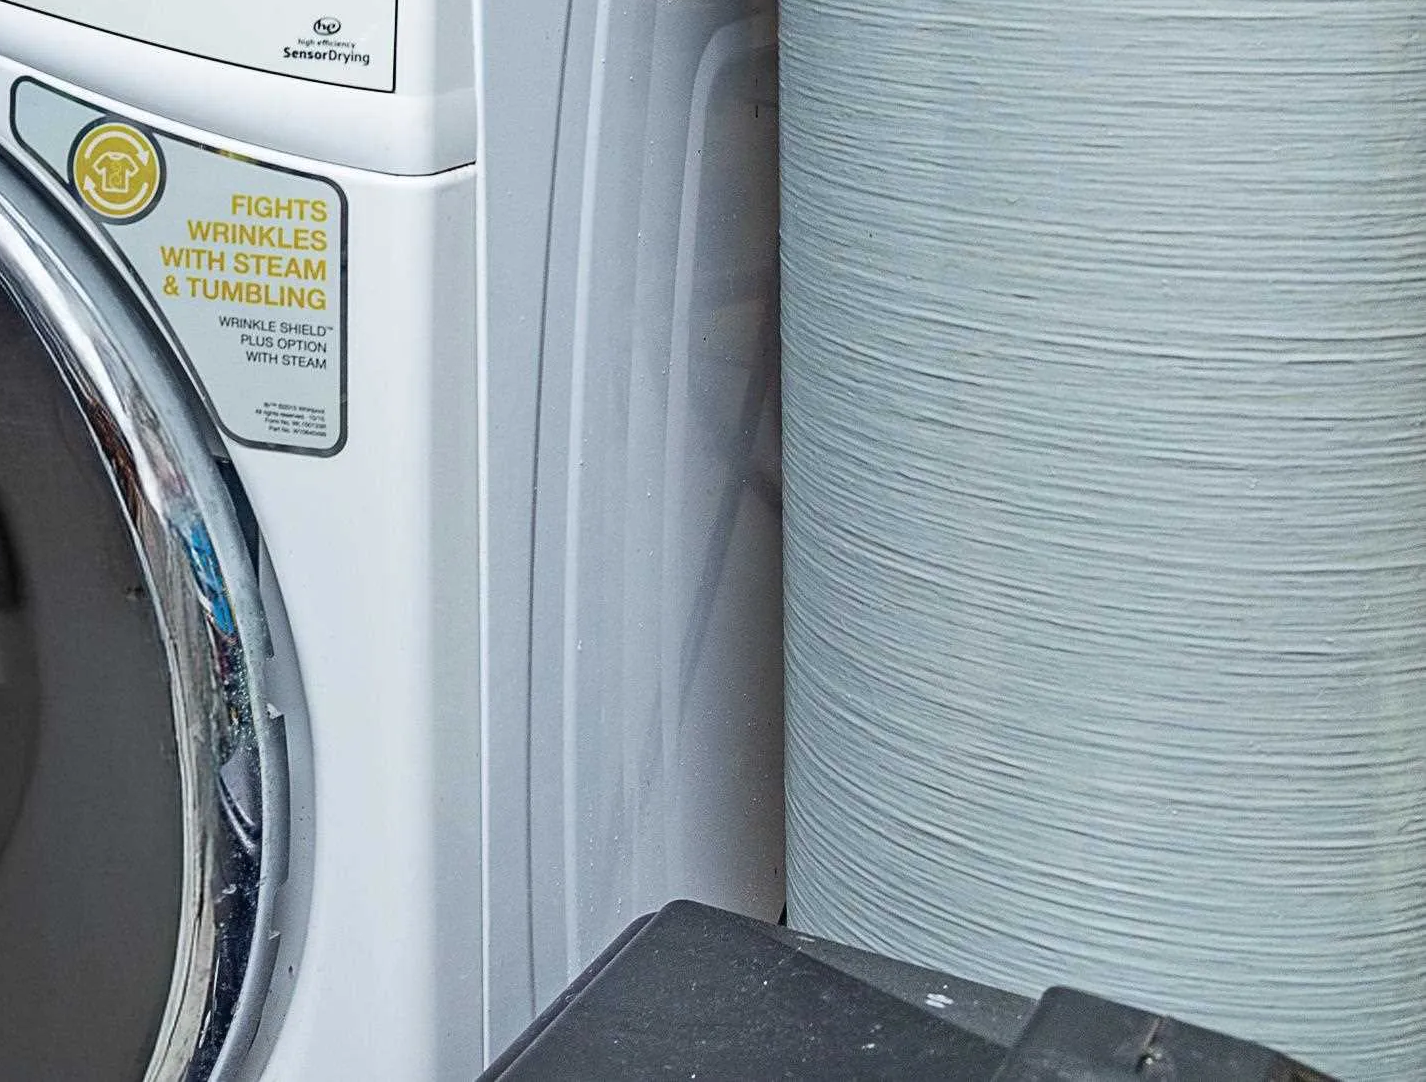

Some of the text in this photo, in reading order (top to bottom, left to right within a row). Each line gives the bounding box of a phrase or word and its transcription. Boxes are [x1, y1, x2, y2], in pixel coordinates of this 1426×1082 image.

[298, 38, 356, 49] high efficiency
[283, 47, 370, 66] SensorDrying
[231, 194, 327, 222] FIGHTS
[187, 220, 327, 251] WRINKLES
[161, 246, 327, 281] WITH STEAM
[163, 276, 327, 311] & TUMBLING
[218, 316, 277, 333] WRINKLE
[240, 334, 327, 353] PLUS OPTION
[246, 351, 327, 369] WITH STEAM
